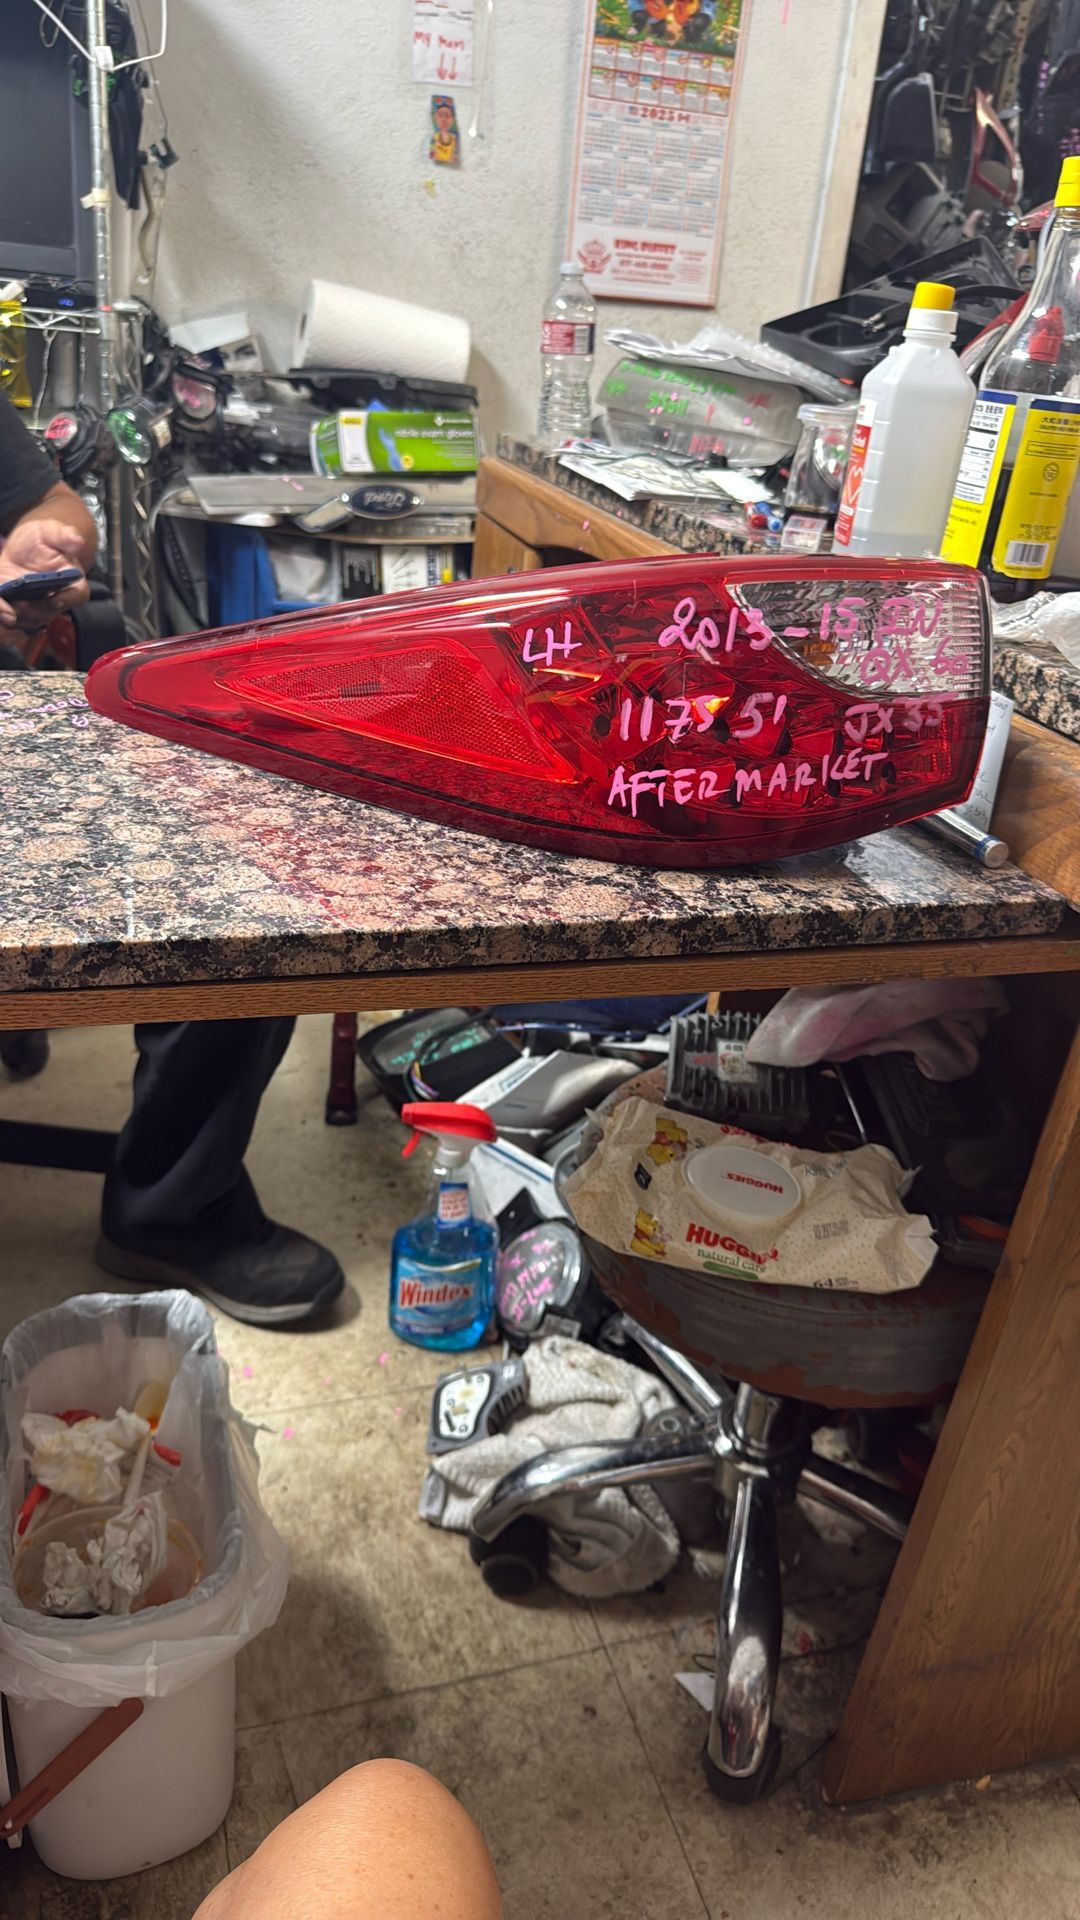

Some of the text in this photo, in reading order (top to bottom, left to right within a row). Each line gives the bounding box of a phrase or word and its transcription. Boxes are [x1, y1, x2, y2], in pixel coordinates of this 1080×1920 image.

[522, 621, 582, 666] LH
[844, 702, 894, 742] JX
[726, 1172, 785, 1195] HUGGIES
[697, 1248, 767, 1274] natural care
[400, 1279, 473, 1308] Windex
